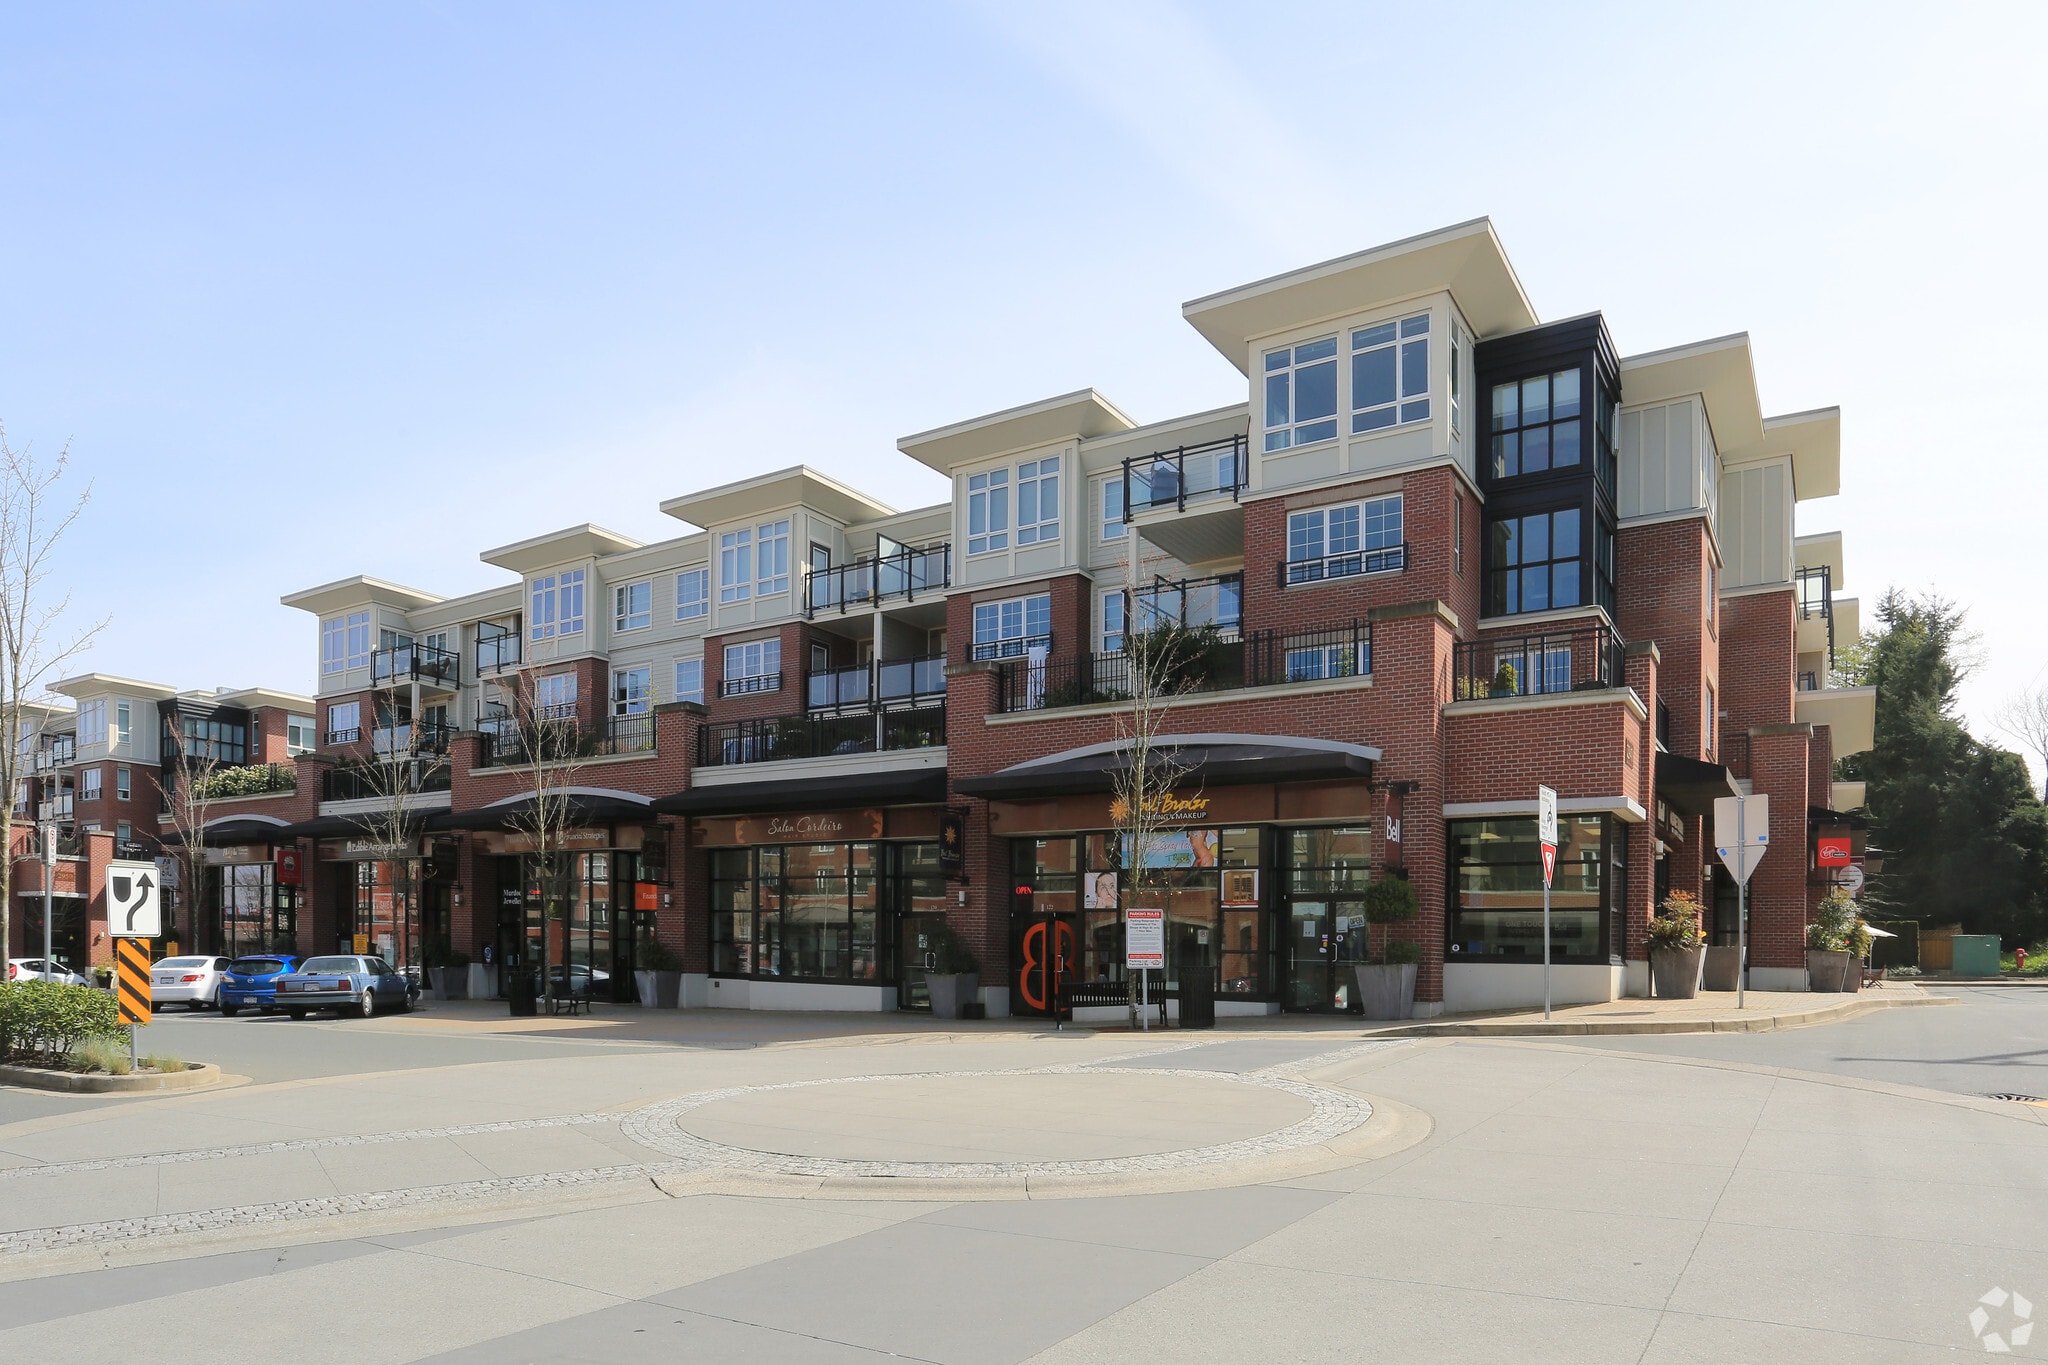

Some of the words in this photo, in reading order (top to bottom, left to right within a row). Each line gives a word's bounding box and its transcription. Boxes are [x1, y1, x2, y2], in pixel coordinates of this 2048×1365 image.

[768, 818, 794, 834] Salon
[797, 816, 842, 833] Cordeiro
[1387, 815, 1400, 842] Bell
[352, 840, 368, 851] Edible
[369, 841, 408, 853] Arrangemnts
[1016, 886, 1033, 895] OPEN
[1523, 920, 1545, 928] TOUC
